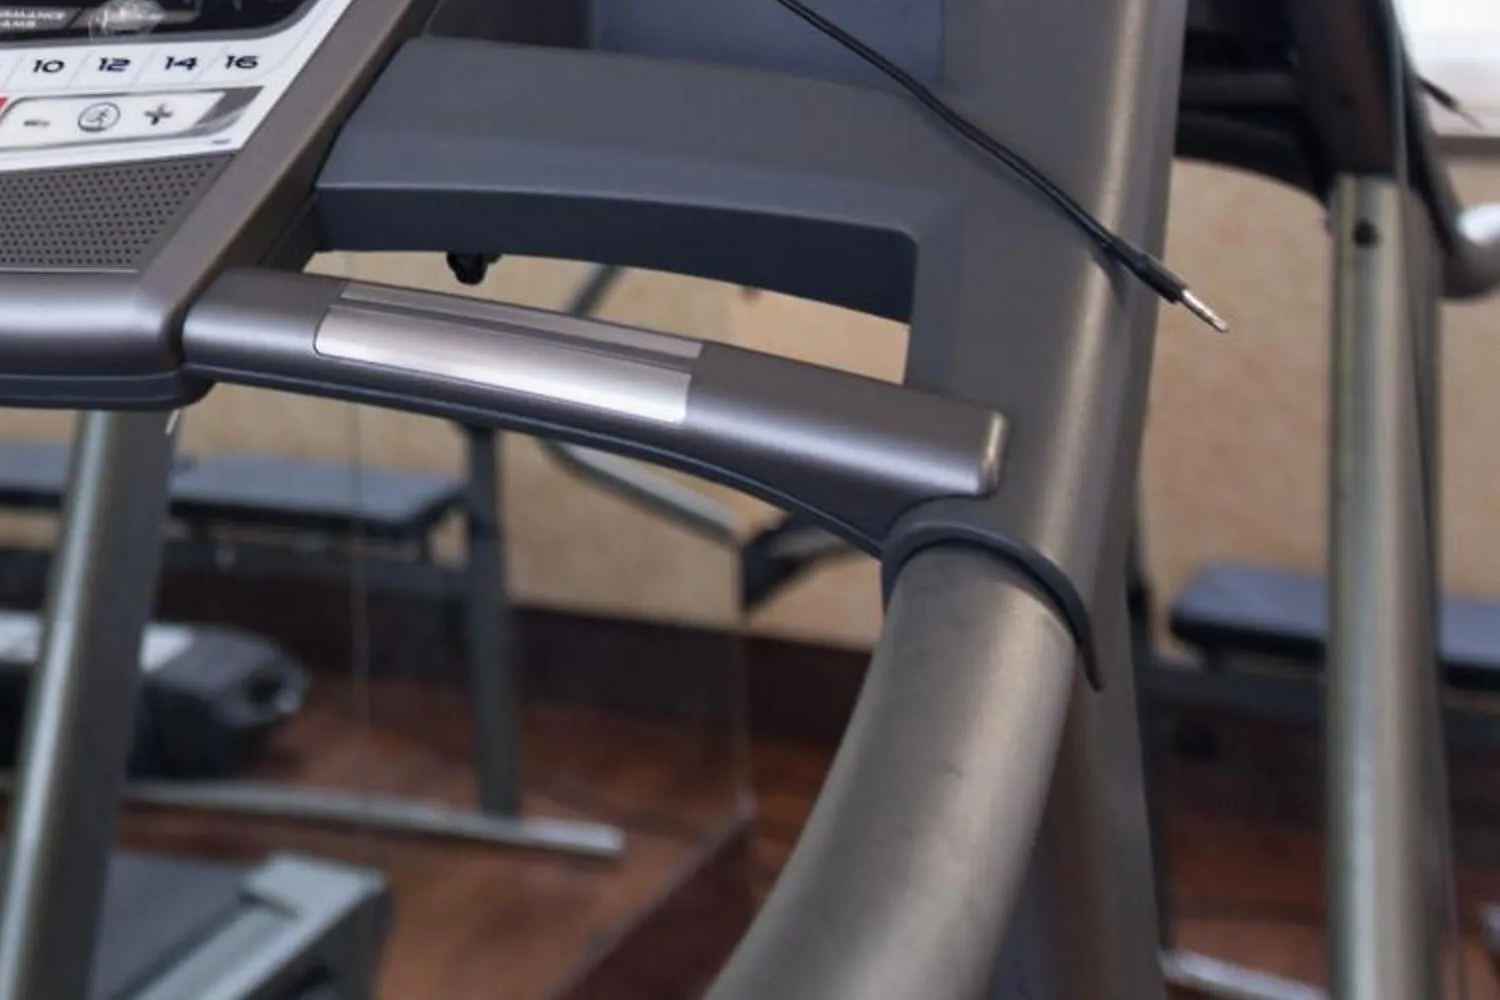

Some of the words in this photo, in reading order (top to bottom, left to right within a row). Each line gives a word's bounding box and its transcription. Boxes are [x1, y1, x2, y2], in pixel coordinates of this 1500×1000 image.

[32, 58, 66, 74] 10
[98, 57, 132, 73] 12
[164, 56, 198, 71] 14
[225, 55, 259, 70] 16
